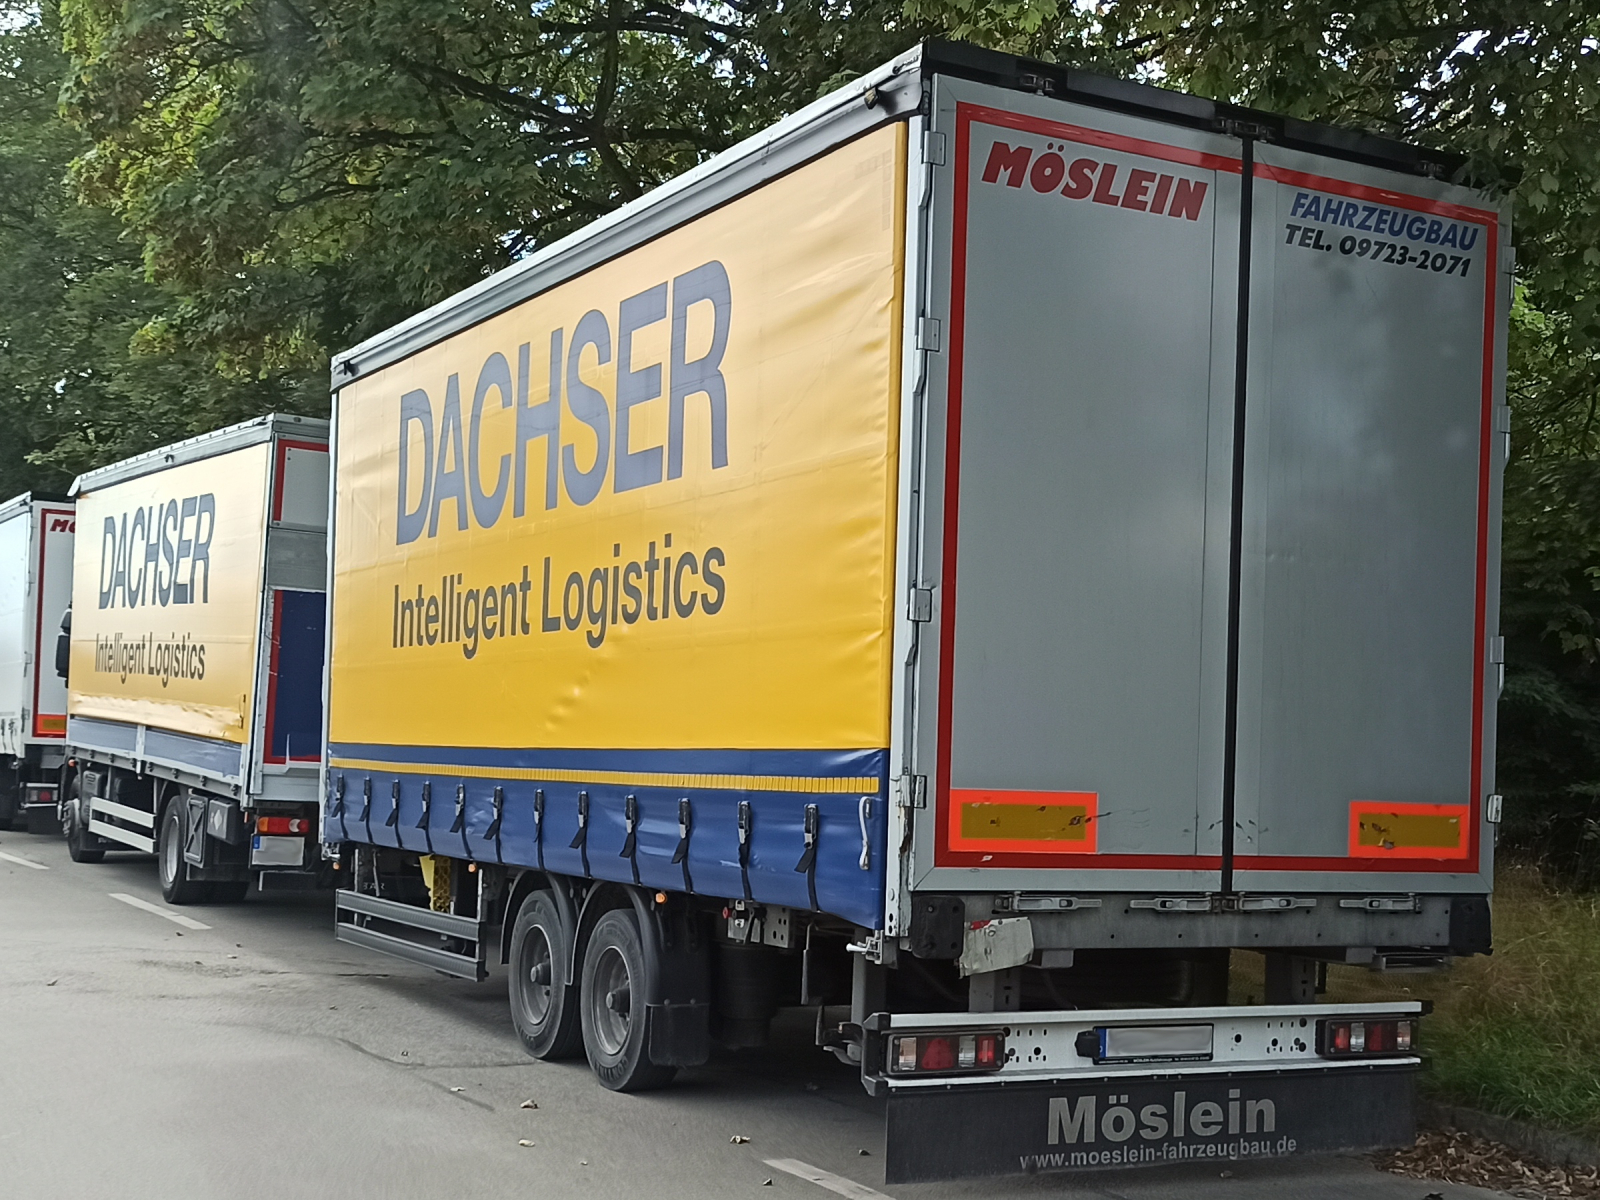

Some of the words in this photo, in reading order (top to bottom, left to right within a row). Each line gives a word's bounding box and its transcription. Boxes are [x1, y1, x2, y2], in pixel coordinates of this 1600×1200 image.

[981, 141, 1209, 221] MÖSLEIN
[1290, 192, 1479, 250] FAHRZEUGBAU
[1285, 224, 1332, 251] TEL.
[1339, 235, 1471, 277] 09723-2071
[396, 260, 732, 545] DACHSER
[98, 493, 215, 609] DACHSER
[392, 565, 531, 659] Intelligent
[542, 533, 726, 648] Logistics
[95, 632, 146, 684] Intelligent
[148, 632, 206, 688] Logistics
[1048, 1088, 1276, 1144] Möslein
[1019, 1135, 1297, 1169] www.moeslein-fahrzeugbau.de
